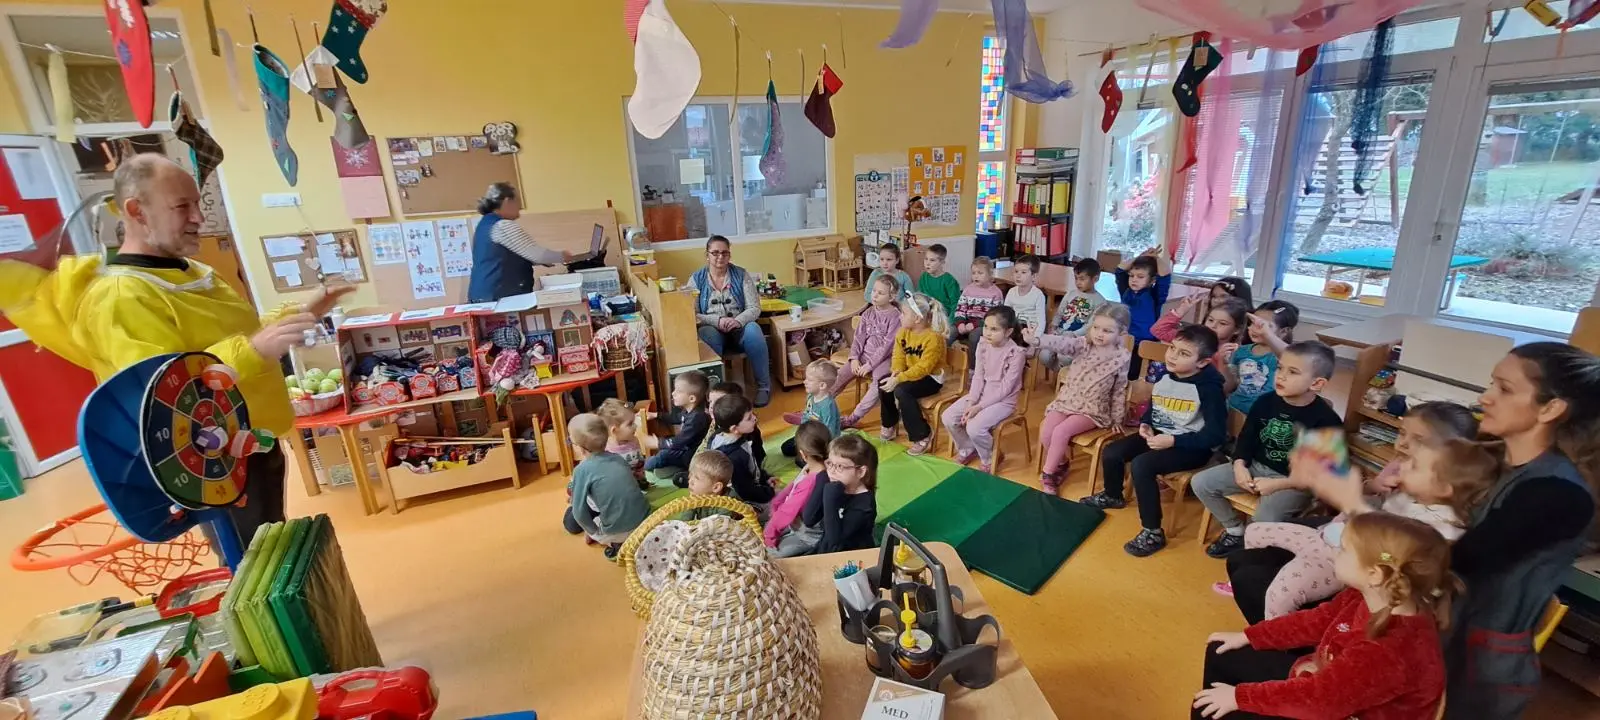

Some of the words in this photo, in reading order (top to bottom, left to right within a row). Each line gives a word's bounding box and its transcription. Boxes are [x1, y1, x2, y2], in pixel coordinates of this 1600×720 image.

[167, 374, 180, 388] 10
[155, 427, 170, 442] 10
[173, 472, 189, 488] 10
[881, 705, 909, 719] MED
